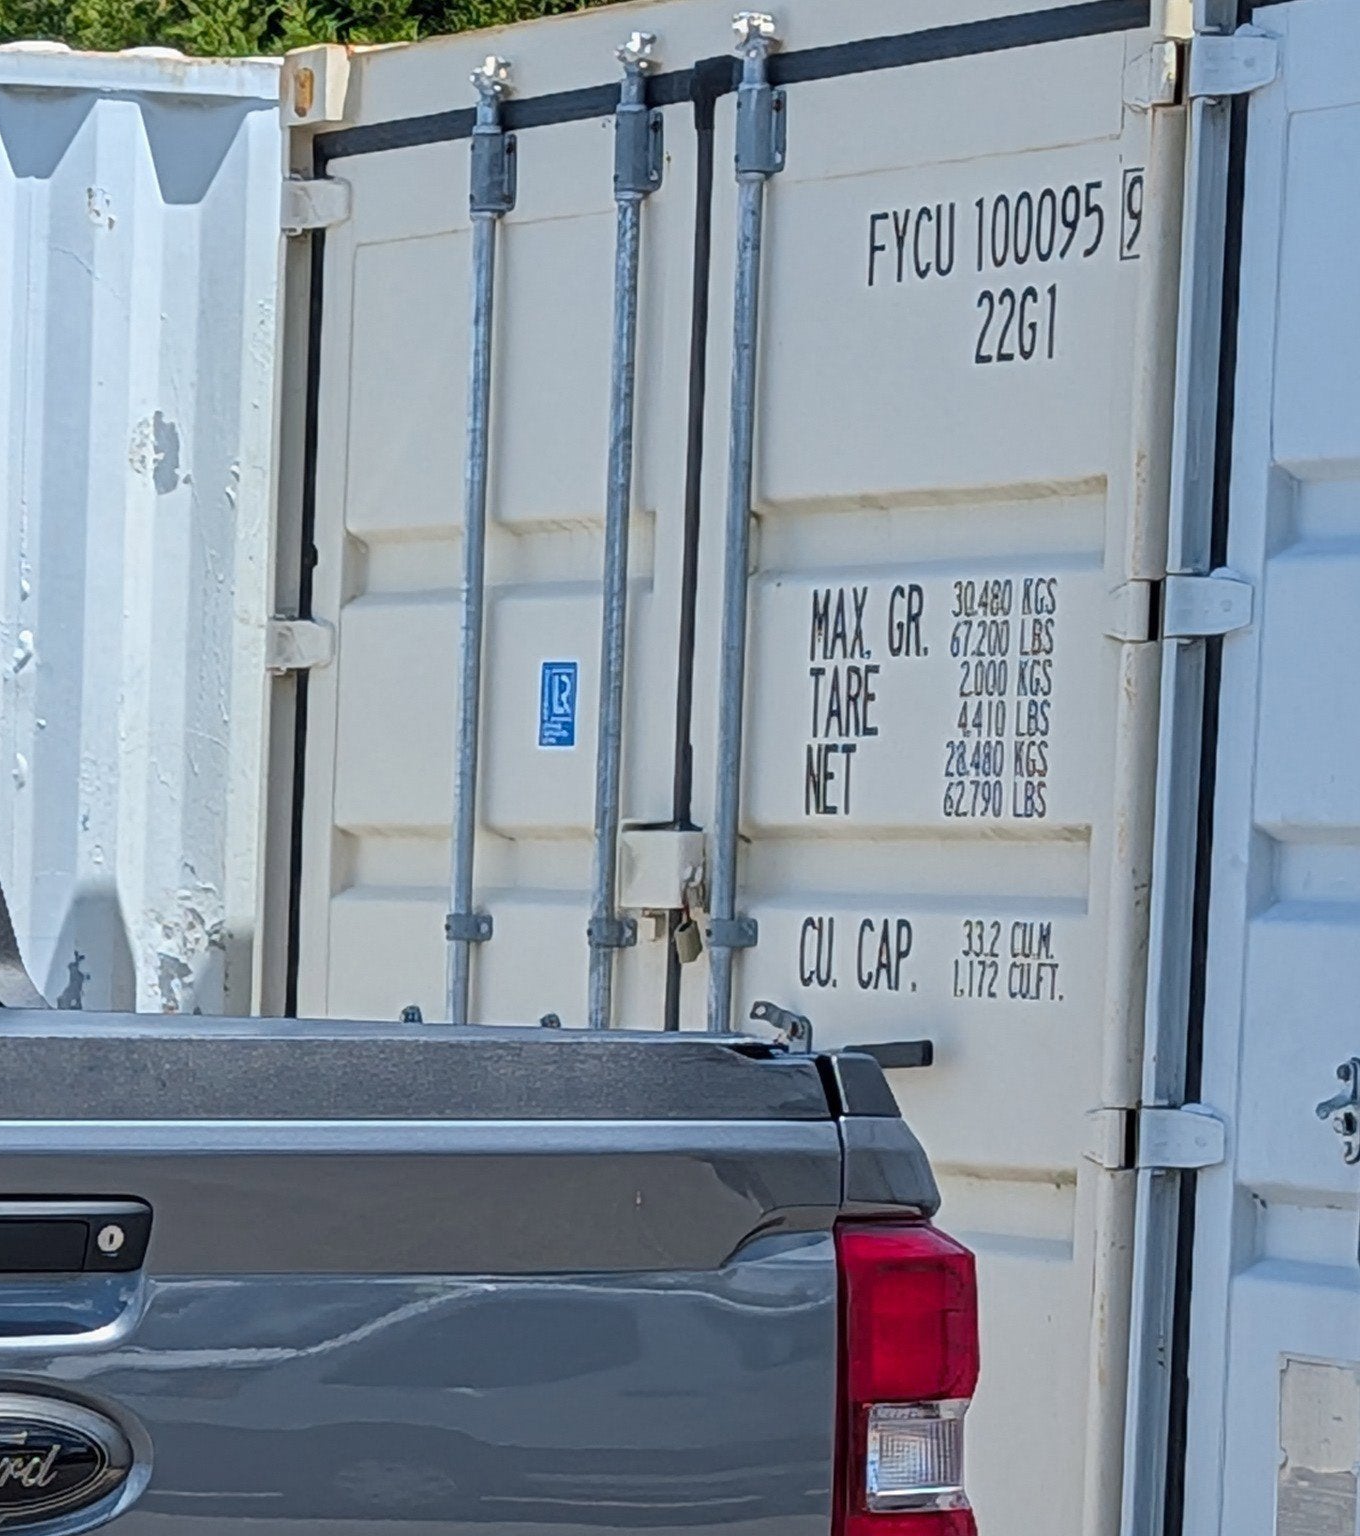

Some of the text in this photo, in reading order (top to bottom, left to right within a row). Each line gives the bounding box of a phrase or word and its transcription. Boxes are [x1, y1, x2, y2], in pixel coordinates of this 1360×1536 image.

[867, 173, 1145, 287] FYCU 100095 9
[974, 283, 1058, 365] 22G1
[887, 583, 929, 658] GR.
[1021, 577, 1058, 616] KGS
[1018, 618, 1055, 657] LBS
[809, 664, 881, 738] TARE
[1015, 658, 1054, 698] KGS
[1015, 699, 1051, 738] LBS
[804, 743, 858, 816] NET
[1013, 740, 1050, 779] KGS
[1011, 780, 1048, 819] LBS
[798, 916, 838, 988] CU.
[857, 917, 918, 992] CAP.
